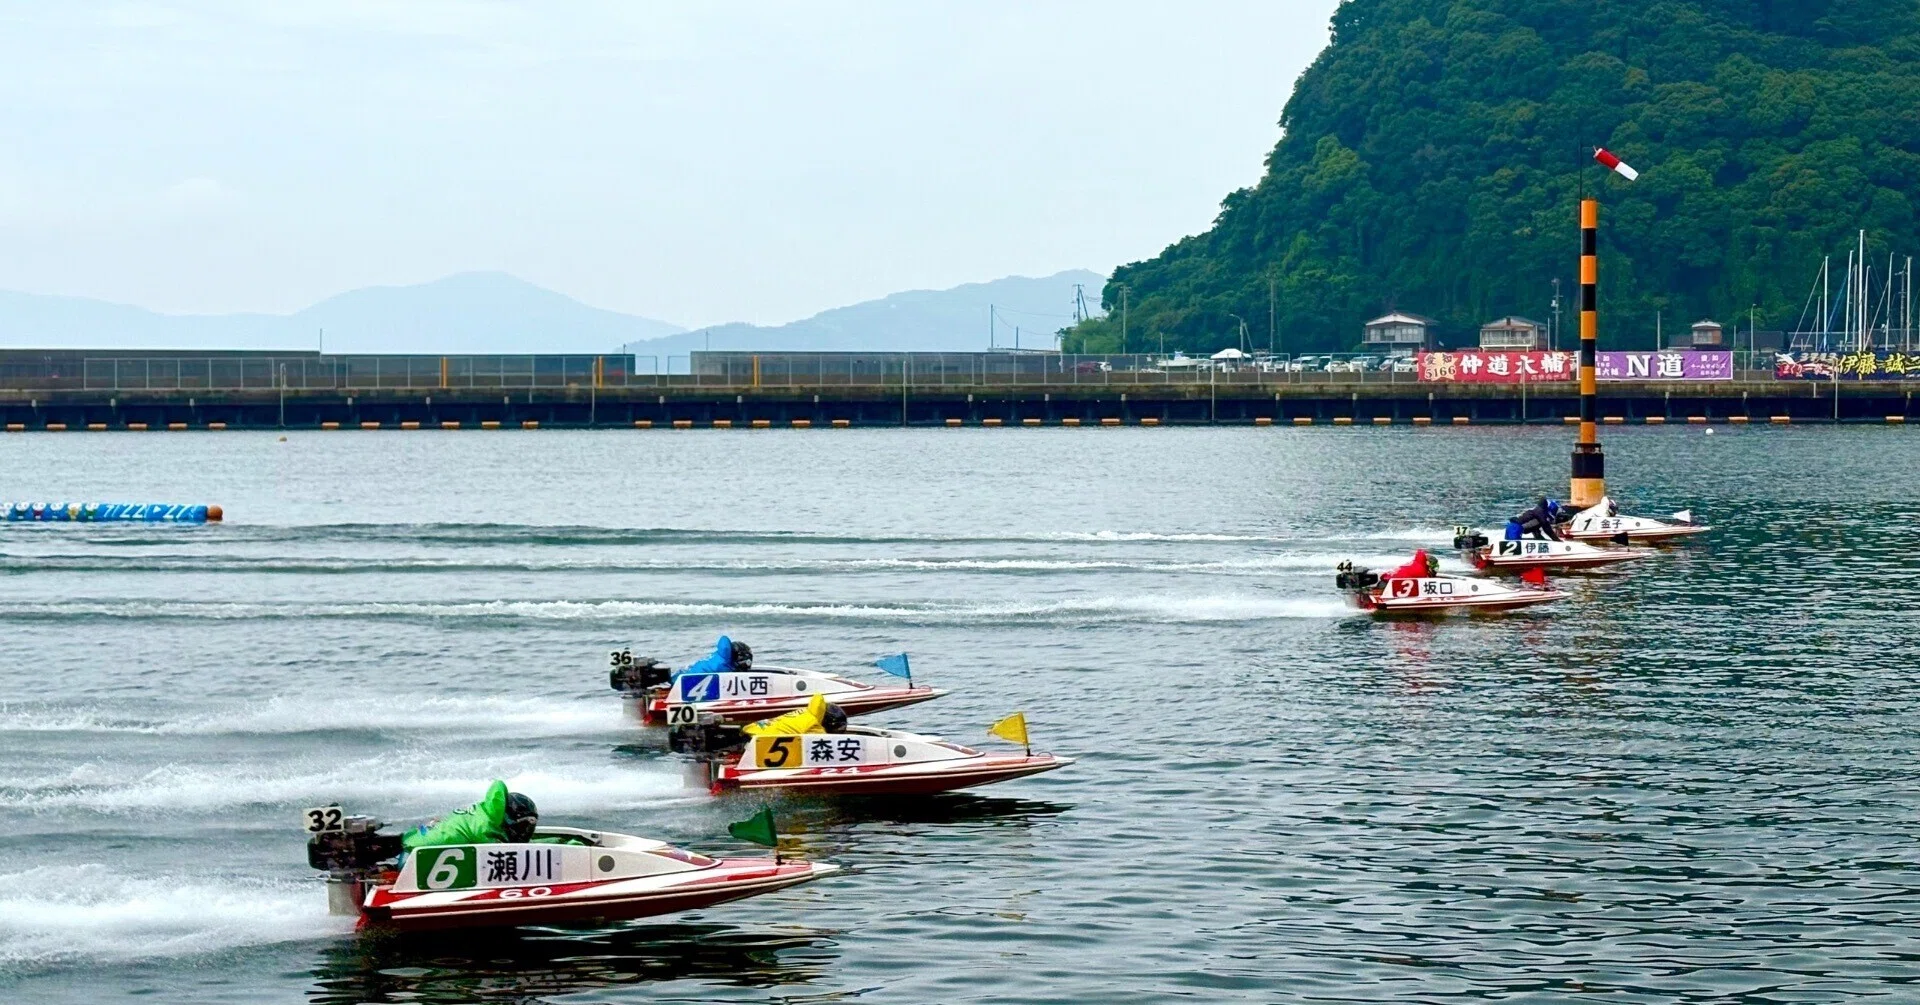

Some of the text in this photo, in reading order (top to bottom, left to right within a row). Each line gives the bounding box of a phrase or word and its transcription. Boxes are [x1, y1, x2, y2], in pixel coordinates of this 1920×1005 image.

[1424, 353, 1453, 365] 愛知
[1460, 353, 1564, 376] 仲道大輔
[1424, 365, 1456, 380] 5166
[1455, 526, 1468, 535] 17
[1583, 518, 1592, 531] 1
[1601, 518, 1622, 529] 金子
[1500, 541, 1518, 555] 2
[1525, 542, 1550, 554] 伊藤
[1336, 562, 1353, 572] 44
[1396, 580, 1414, 597] 3
[1423, 581, 1453, 595] 坂口
[610, 651, 632, 666] 36
[687, 675, 713, 701] 4
[726, 676, 769, 696] 小西
[669, 706, 695, 723] 70
[763, 737, 795, 767] 5
[810, 737, 861, 763] 森安
[820, 767, 861, 775] 24
[307, 809, 342, 832] 32
[426, 848, 465, 889] 6
[486, 848, 552, 883] 瀬川
[499, 886, 552, 899] 60
